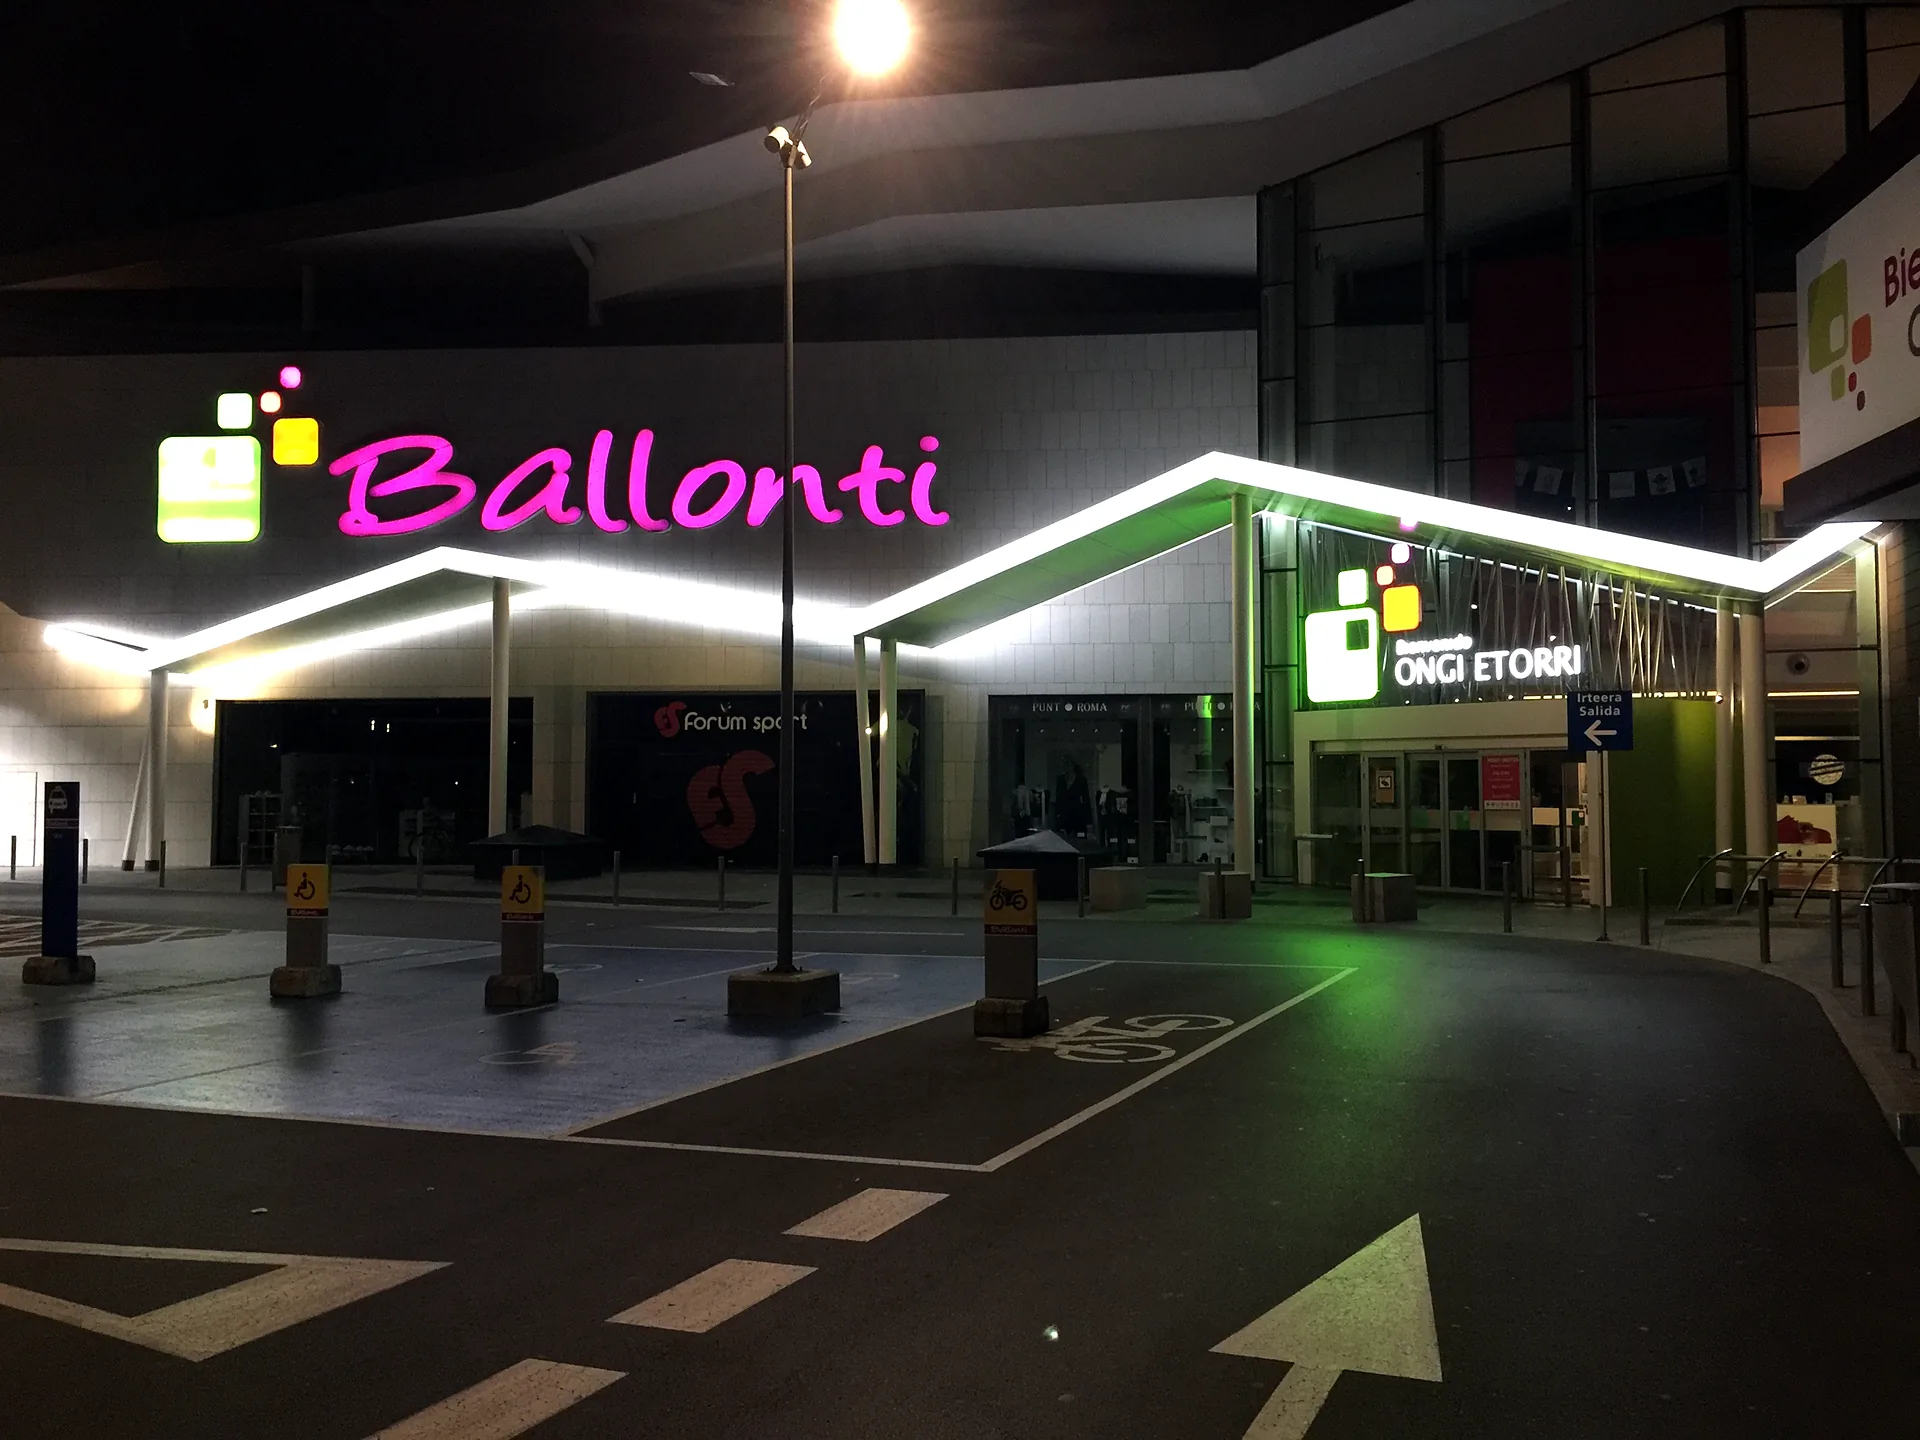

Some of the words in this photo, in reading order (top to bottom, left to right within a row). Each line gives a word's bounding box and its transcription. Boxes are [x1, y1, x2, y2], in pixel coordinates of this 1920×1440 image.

[329, 428, 951, 537] Ballonti
[1394, 653, 1465, 687] ONGI
[1474, 644, 1582, 682] ETORRI
[1577, 693, 1622, 703] Irteera
[1032, 702, 1061, 712] PUNT
[1076, 702, 1108, 712] ROMA
[1579, 705, 1621, 717] Salida
